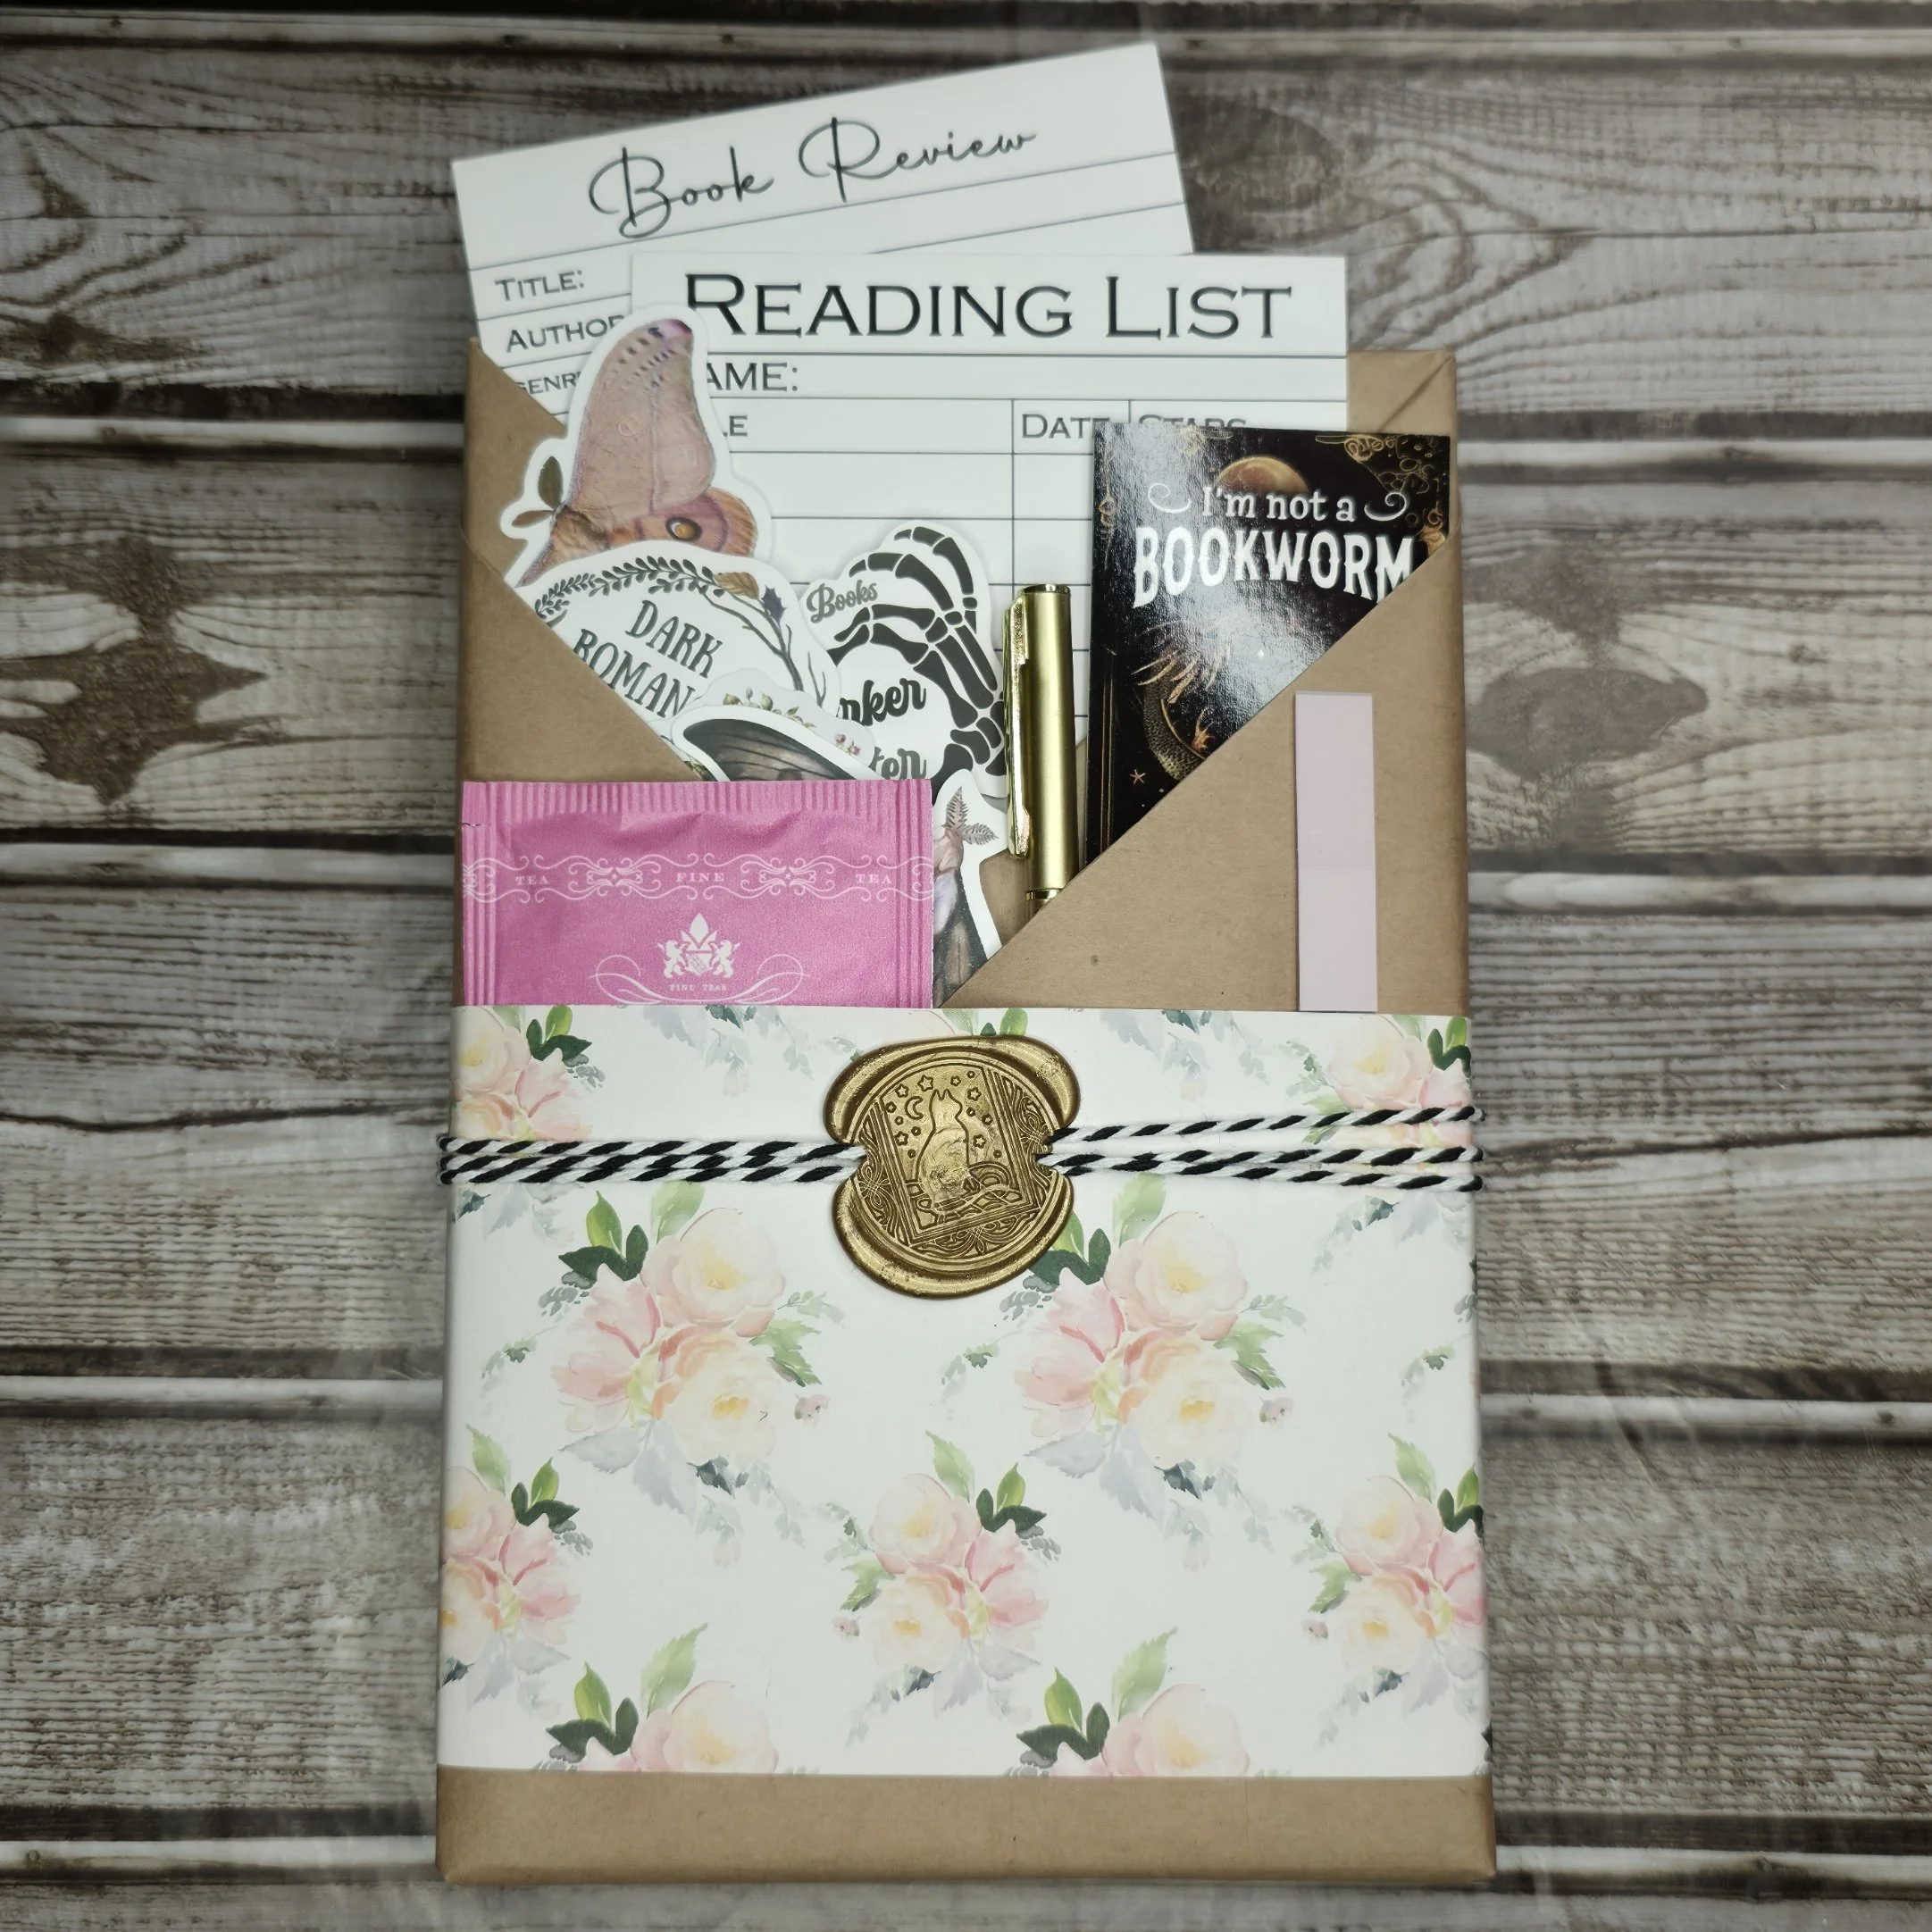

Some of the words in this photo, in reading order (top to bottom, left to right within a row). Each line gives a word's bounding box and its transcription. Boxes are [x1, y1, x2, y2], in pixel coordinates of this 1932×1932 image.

[589, 146, 775, 239] Book
[798, 117, 1036, 204] Review
[495, 270, 585, 301] TITLE:
[686, 272, 1073, 339] READING
[1105, 275, 1292, 339] LIST
[516, 371, 582, 395] ENR
[706, 361, 799, 392] AME:
[1021, 414, 1110, 439] DAT
[1201, 487, 1256, 518] I'm
[1266, 491, 1326, 521] not
[1335, 496, 1356, 523] a
[1133, 525, 1414, 609] BOOKWORM
[806, 579, 879, 624] Books
[624, 599, 723, 679] DARK
[573, 628, 697, 718] ROMAN
[515, 875, 550, 885] TEA
[675, 873, 725, 882] FINE
[855, 874, 893, 884] TEA
